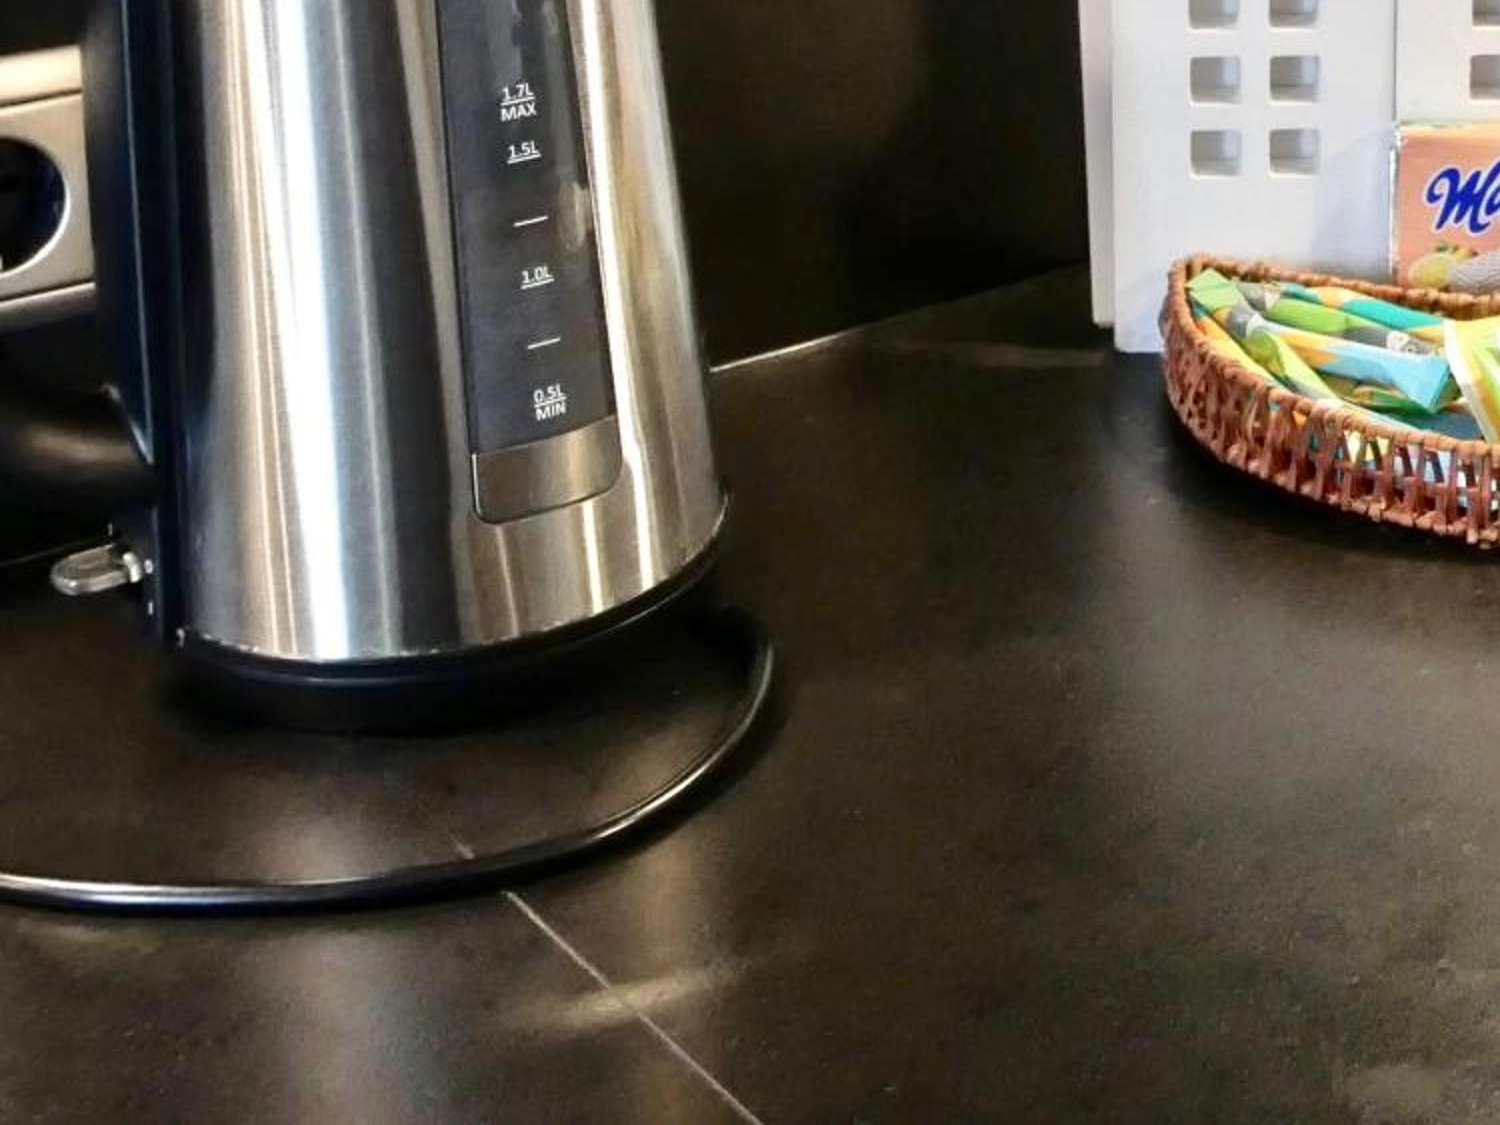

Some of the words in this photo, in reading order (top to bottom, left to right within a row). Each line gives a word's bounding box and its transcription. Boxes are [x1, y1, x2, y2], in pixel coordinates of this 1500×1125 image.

[501, 82, 535, 103] 1.7L
[501, 103, 536, 122] MAX
[508, 140, 540, 160] 1.5L
[521, 265, 553, 285] 1.0L
[534, 384, 567, 404] 0.5L
[536, 402, 567, 421] MIN
